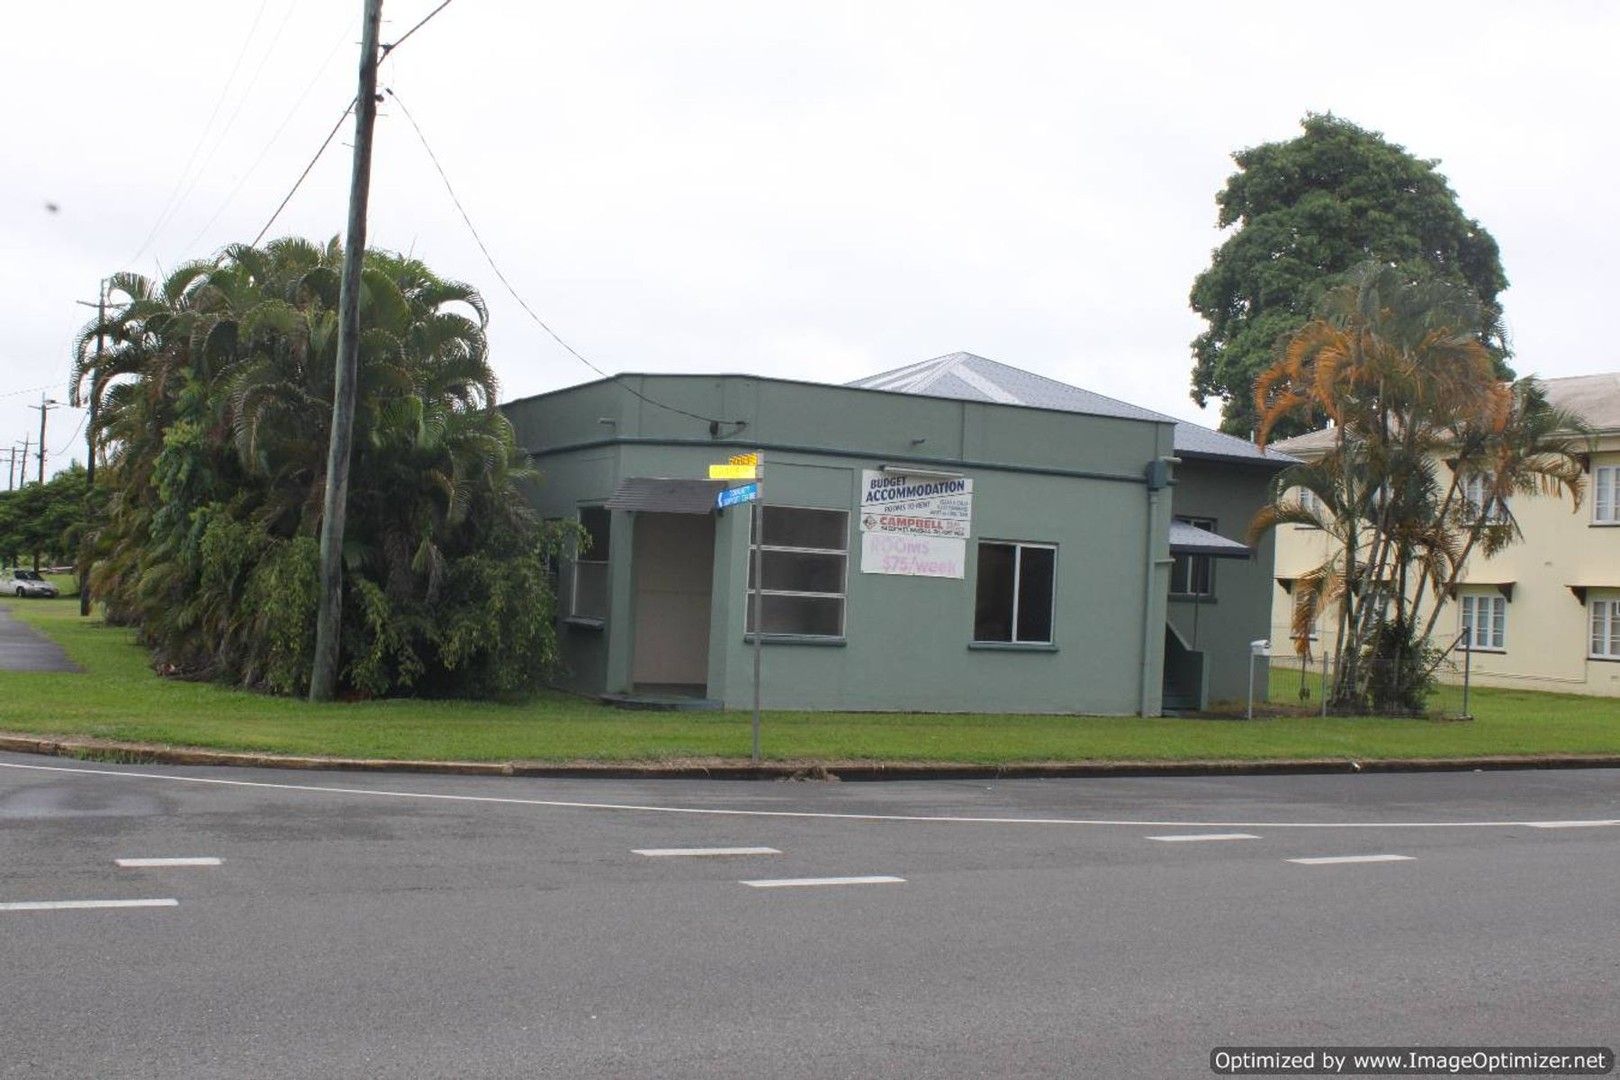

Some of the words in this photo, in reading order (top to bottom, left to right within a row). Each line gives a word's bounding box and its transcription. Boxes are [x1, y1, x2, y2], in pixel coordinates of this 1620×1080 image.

[870, 476, 906, 490] BUDGET
[866, 480, 965, 502] ACCOMMODATION
[879, 516, 943, 530] CAMPBELL
